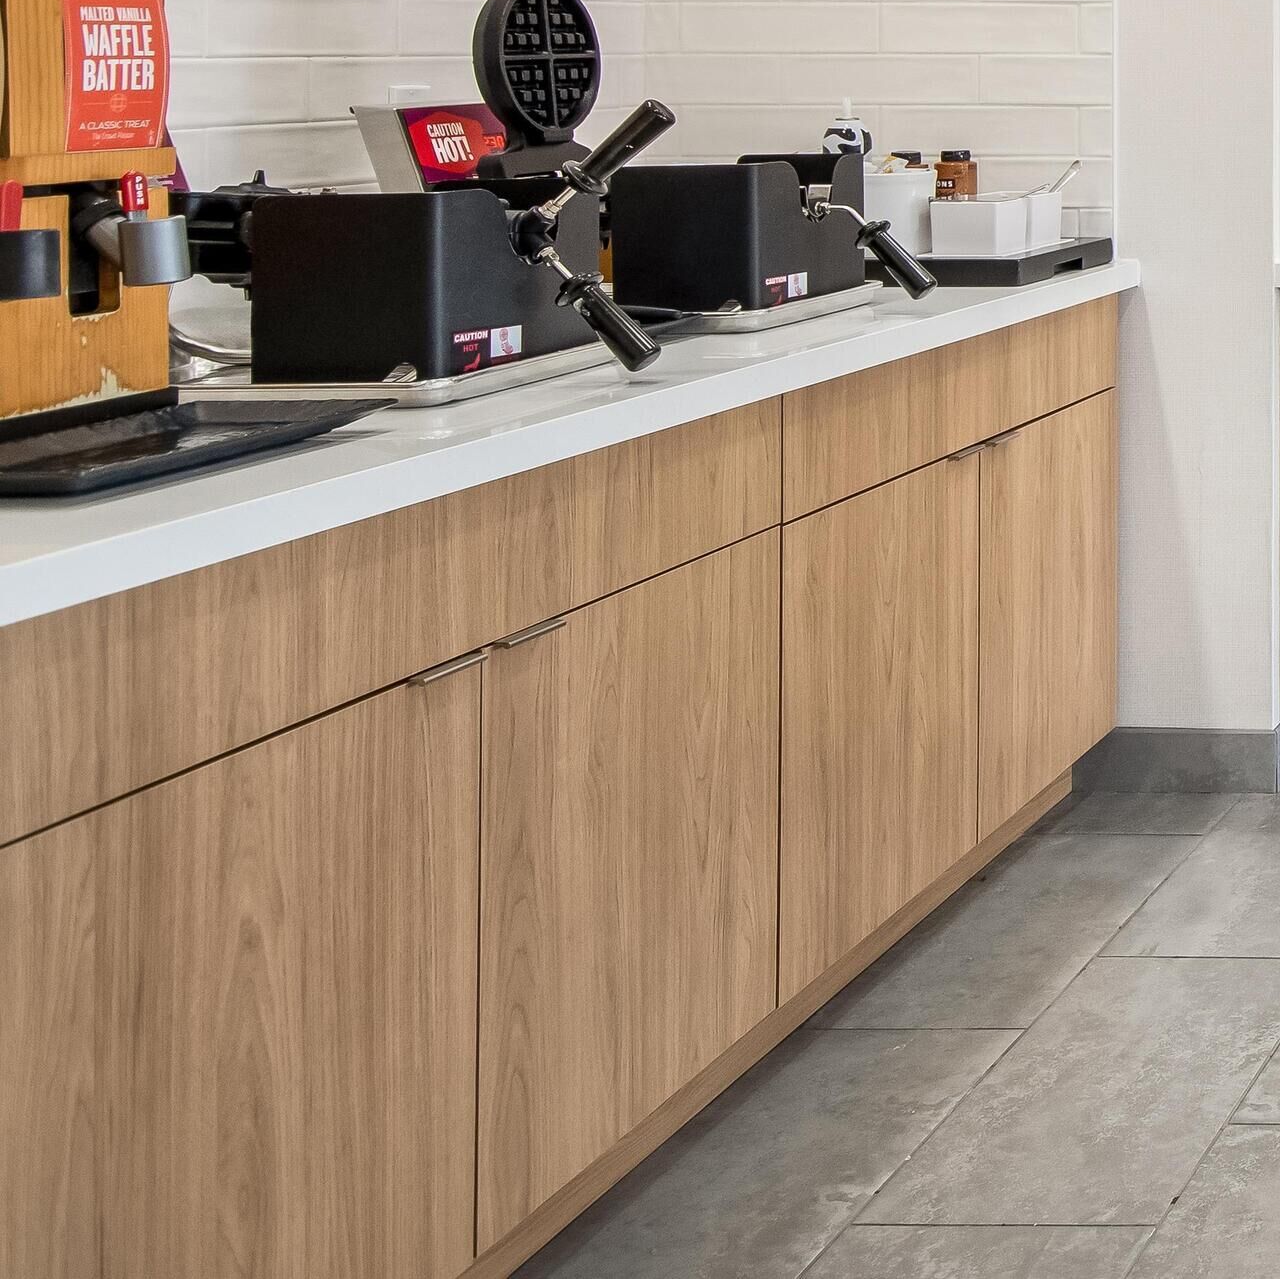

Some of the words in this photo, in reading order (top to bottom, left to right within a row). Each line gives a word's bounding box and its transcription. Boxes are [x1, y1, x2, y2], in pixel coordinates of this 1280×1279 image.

[79, 6, 114, 21] MALTED
[116, 7, 152, 22] VANILLA
[82, 24, 155, 57] WAFFLE
[82, 59, 155, 92] BATTER
[79, 122, 85, 130] A
[87, 120, 123, 130] CLASSIC
[125, 119, 151, 128] TREAT
[426, 122, 465, 138] CAUTION
[431, 135, 475, 164] HOT!
[135, 176, 145, 205] PUSH
[454, 330, 489, 344] CAUTION
[463, 344, 479, 352] HOT
